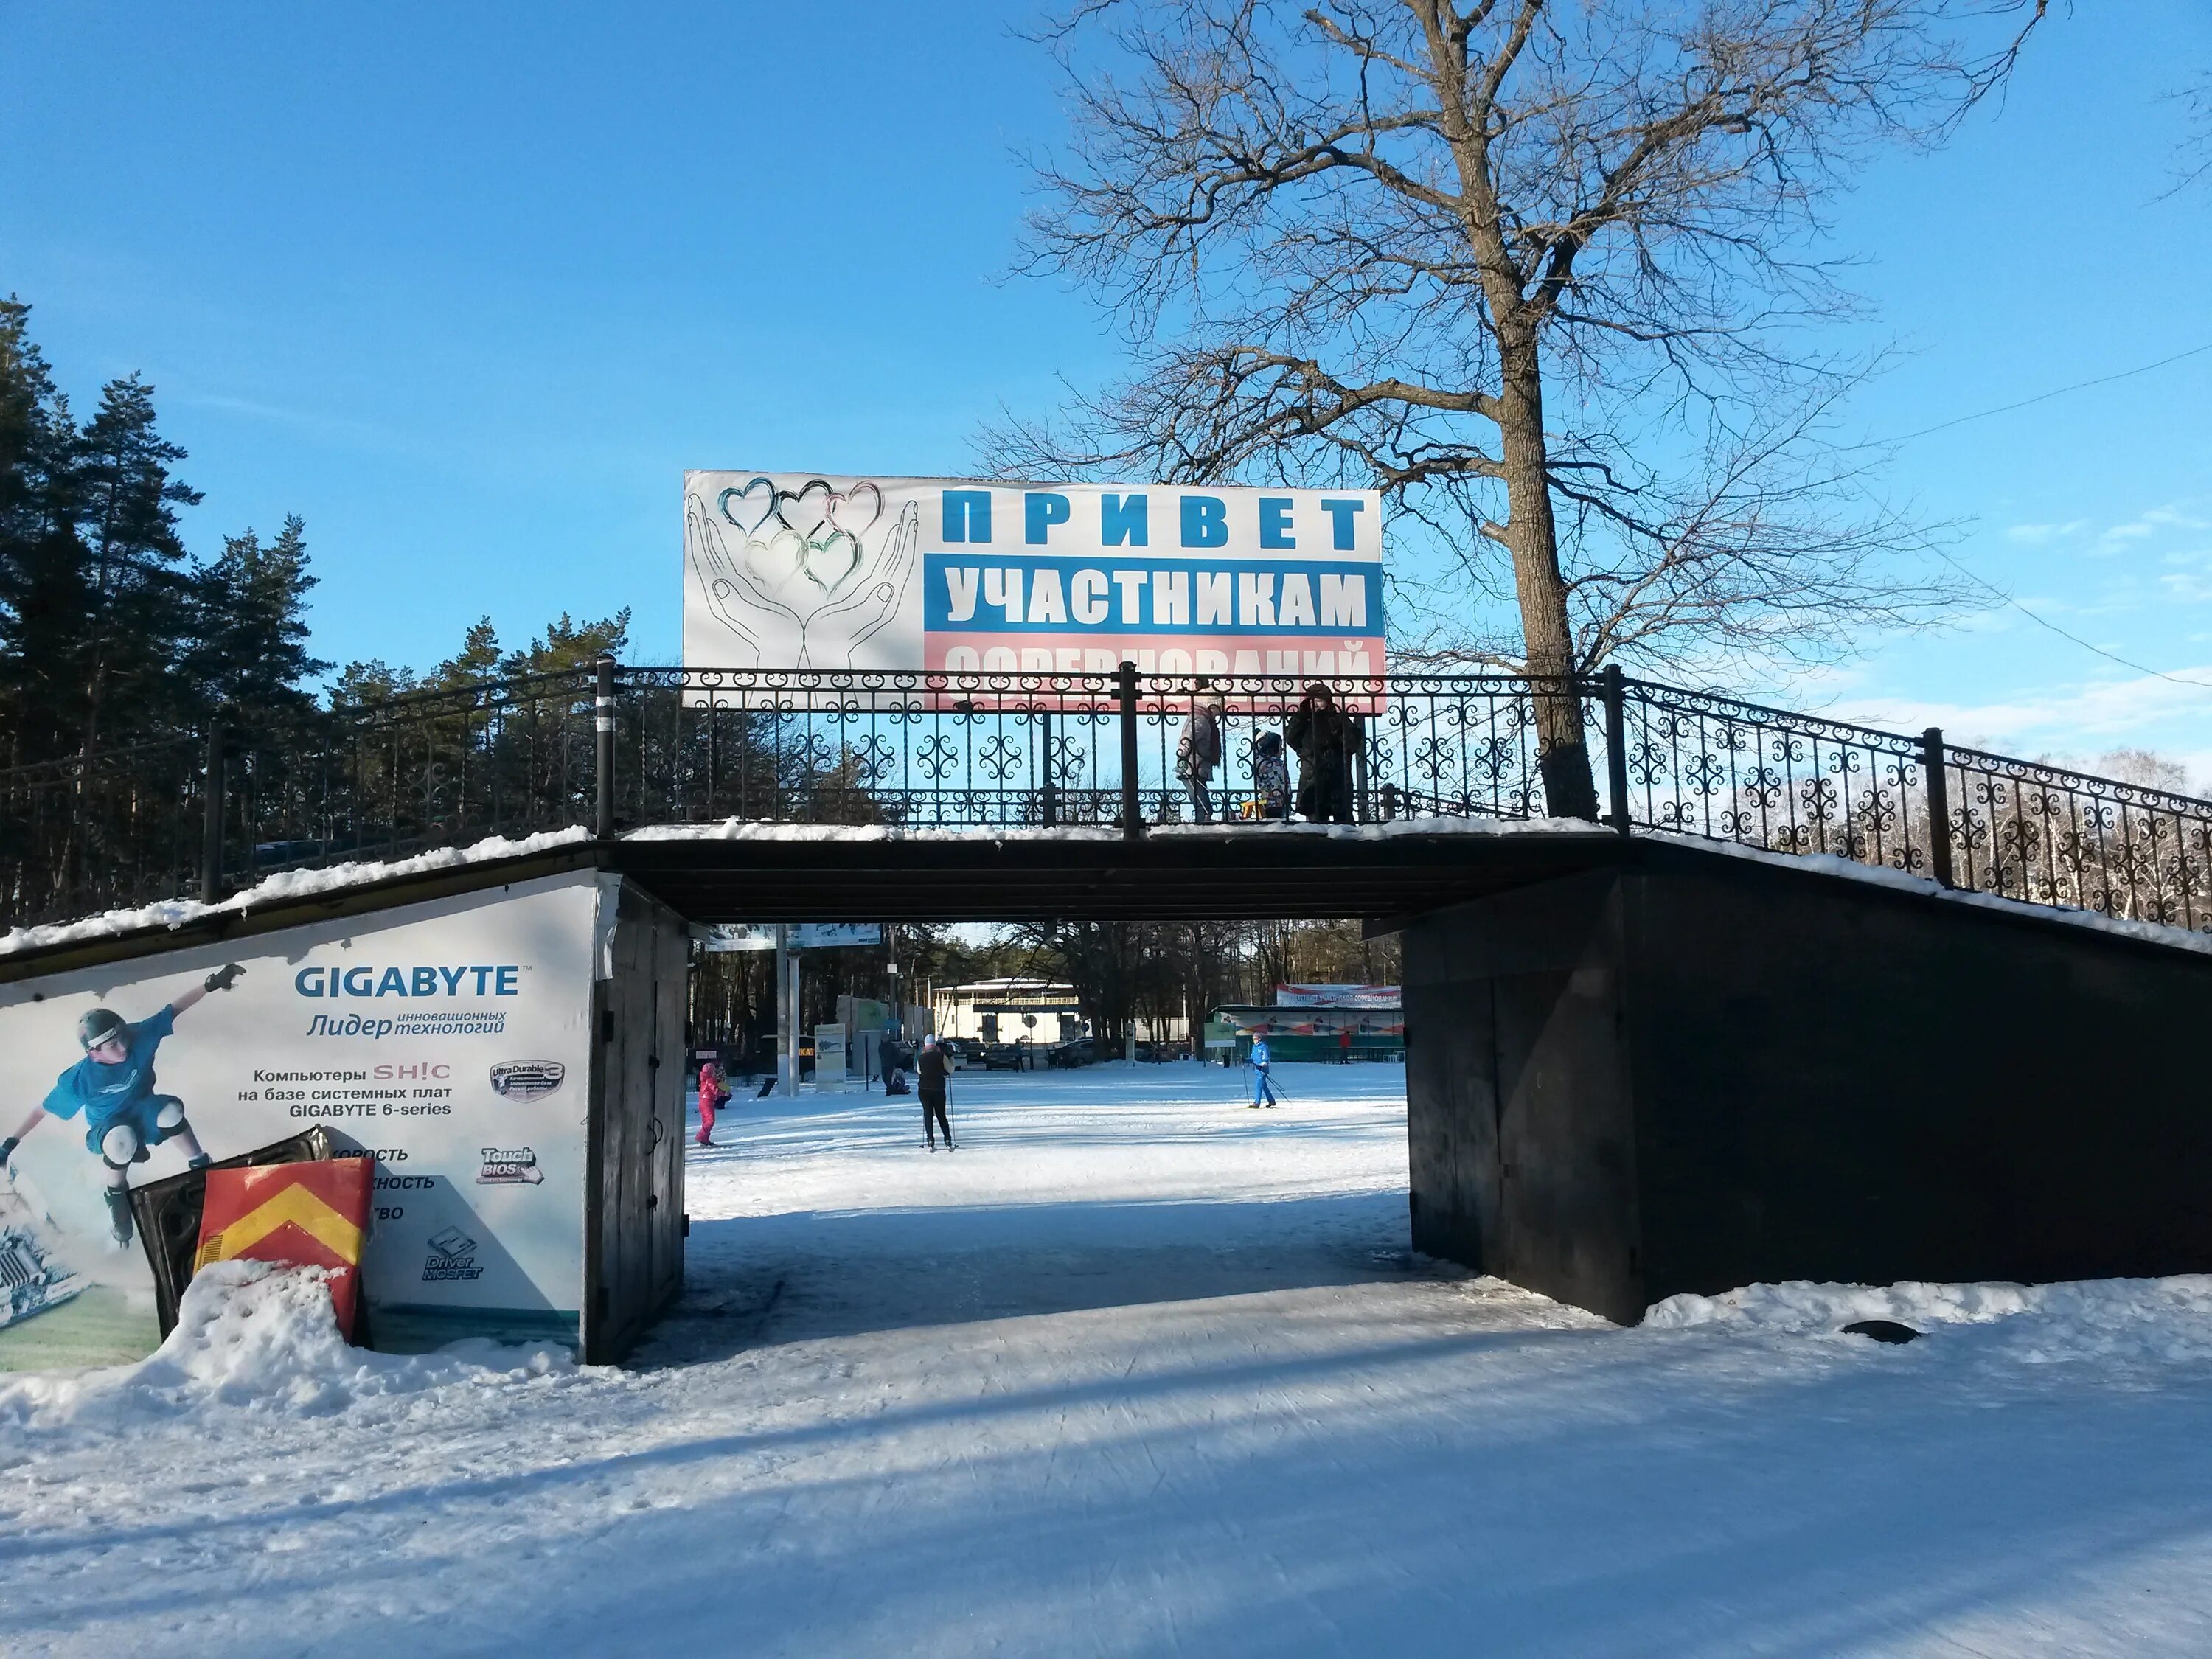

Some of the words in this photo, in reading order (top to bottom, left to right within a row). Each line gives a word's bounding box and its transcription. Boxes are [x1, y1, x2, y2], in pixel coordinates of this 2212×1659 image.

[942, 490, 1364, 551] ПРИВЕТ
[944, 566, 1367, 627] УЧАСТНИКАМ
[295, 965, 518, 998] GIGABYTE
[397, 1012, 507, 1023] инновационных
[307, 1013, 392, 1039] Лидер
[394, 1020, 504, 1034] технологий
[254, 1069, 366, 1083] Компьютеры
[493, 1067, 512, 1077] Ultra
[512, 1065, 544, 1073] Durable
[238, 1091, 258, 1101] на
[264, 1088, 305, 1101] базе
[311, 1088, 406, 1099] системных
[413, 1088, 452, 1098] плат
[289, 1104, 376, 1117] GIGABYTE
[382, 1103, 451, 1116] 6-series
[482, 1147, 534, 1163] Touch
[481, 1164, 517, 1177] BIOS
[426, 1256, 474, 1268] Driver
[422, 1267, 484, 1281] MOSFET
